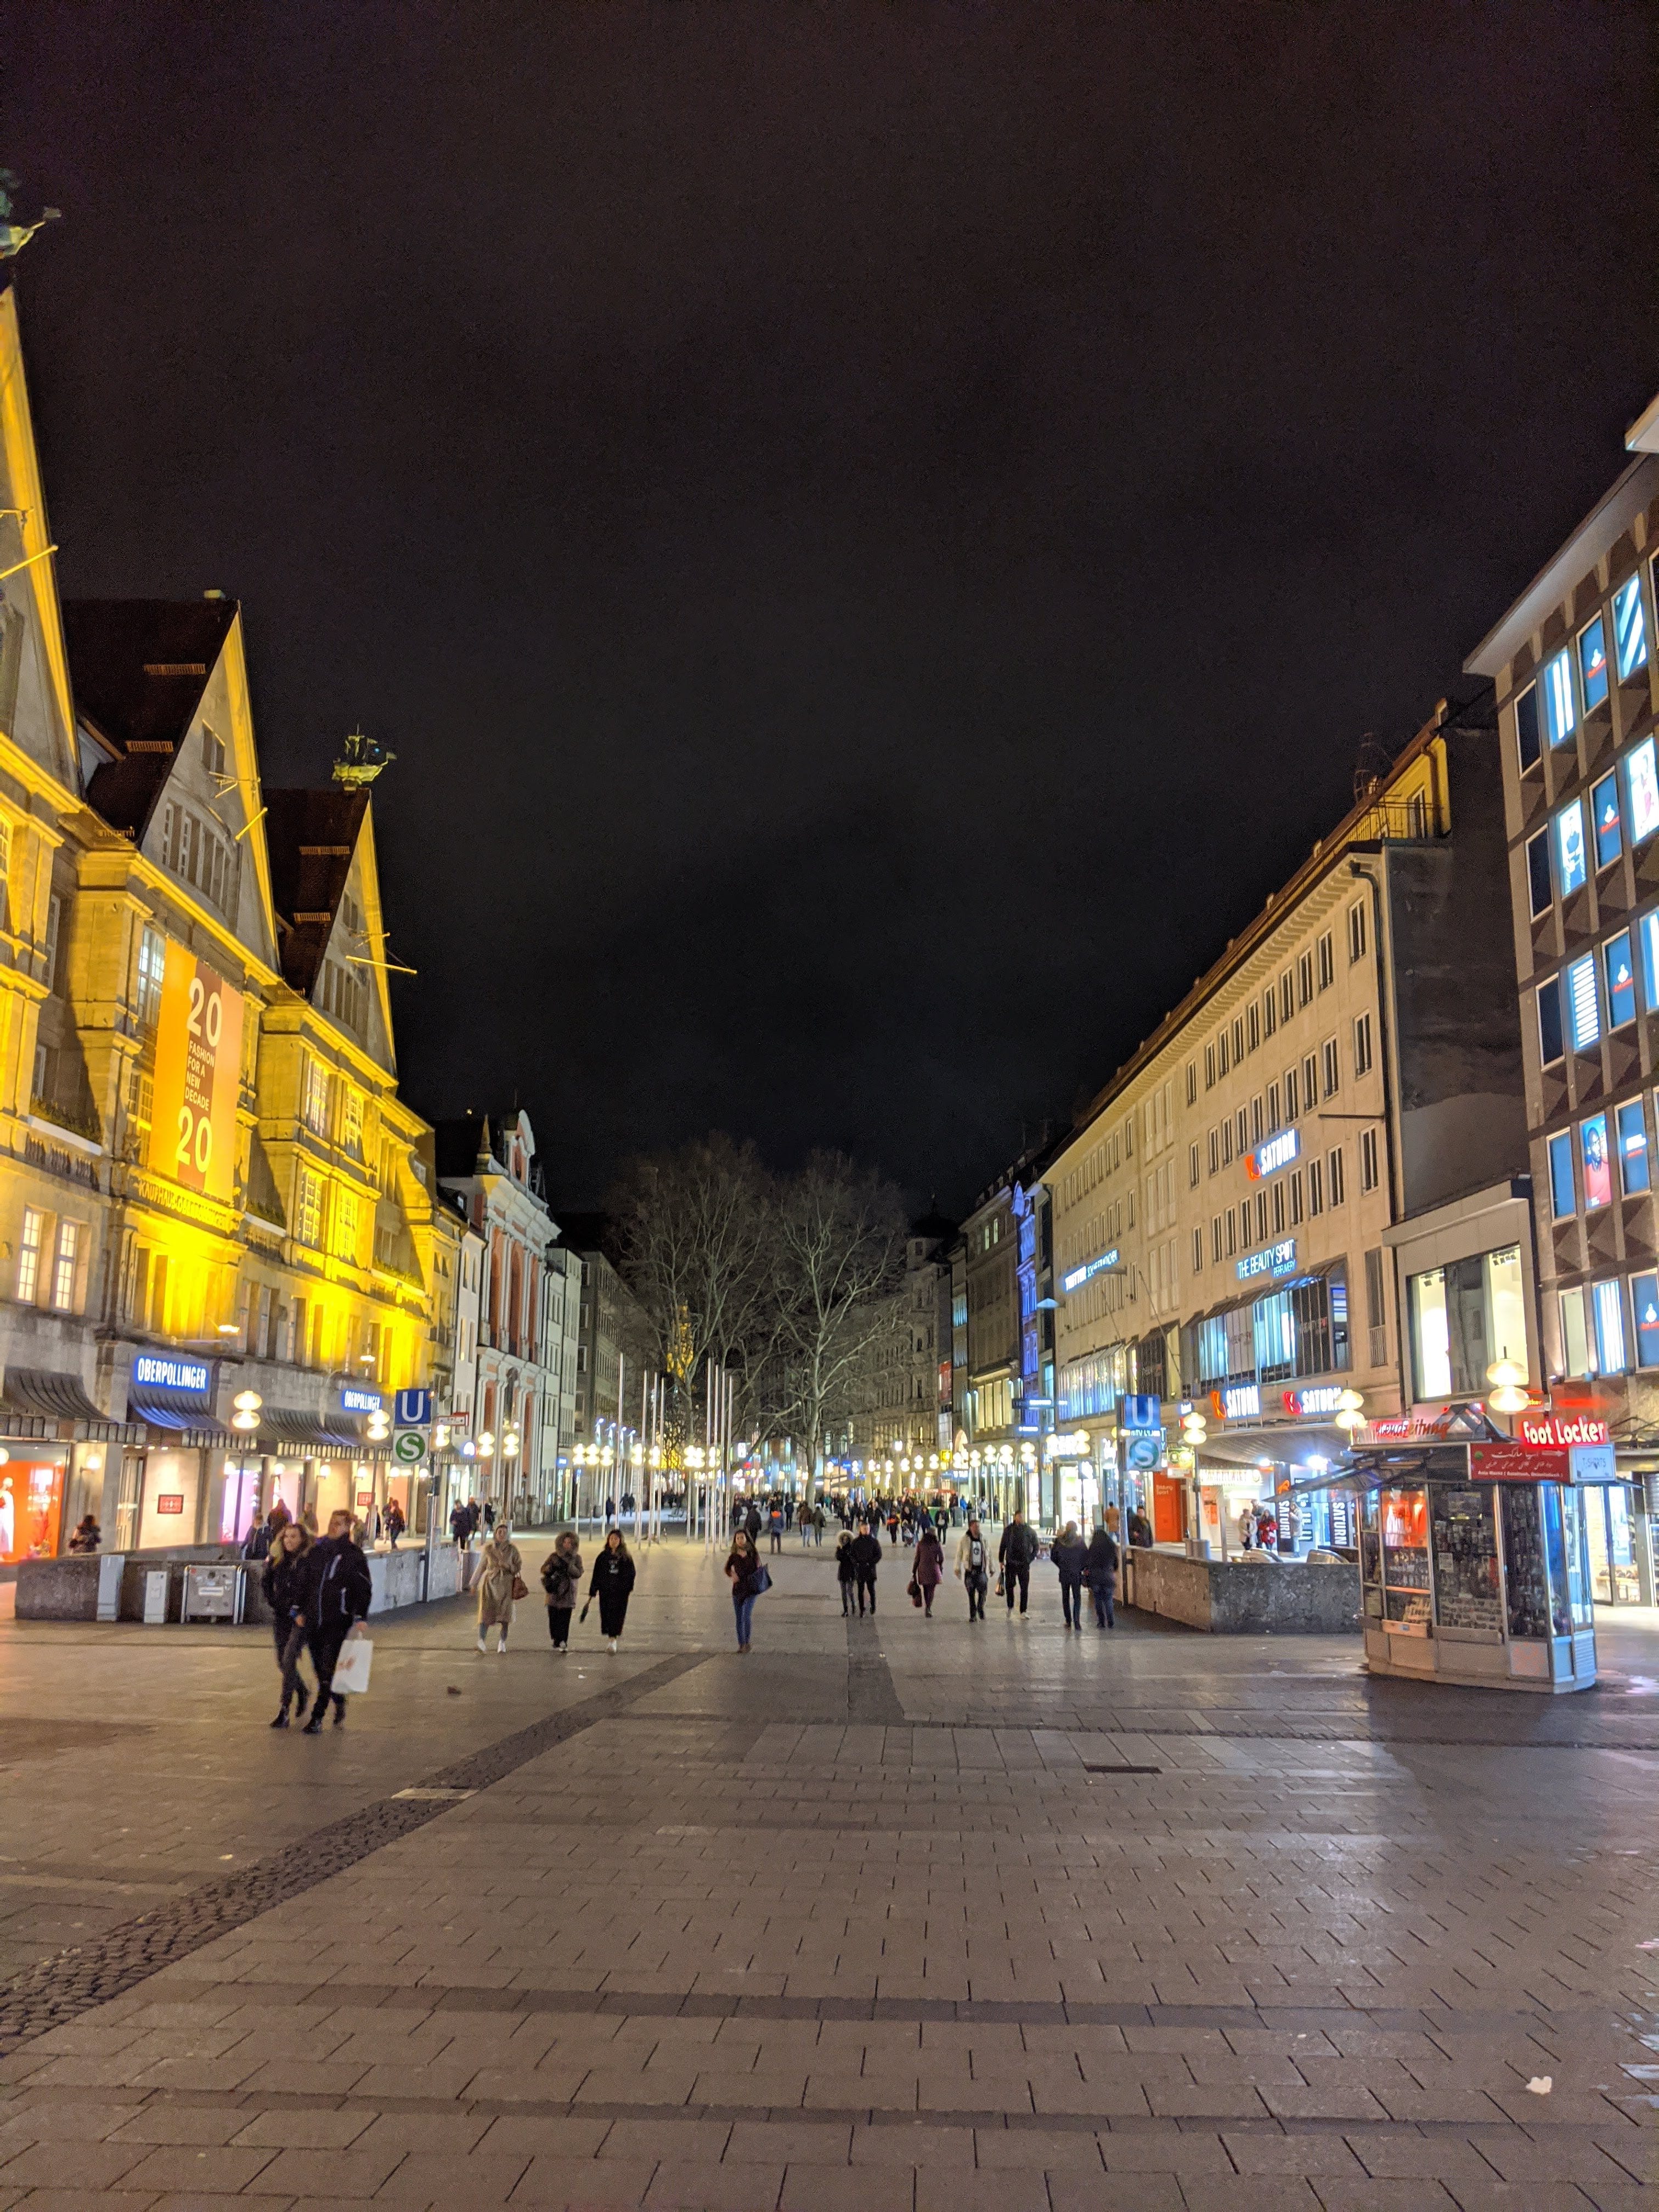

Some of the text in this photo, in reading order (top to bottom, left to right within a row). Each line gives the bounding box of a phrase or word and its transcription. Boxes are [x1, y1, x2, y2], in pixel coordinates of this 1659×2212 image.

[187, 978, 223, 1047] 20
[188, 1056, 205, 1077] FOR A
[189, 1040, 215, 1068] FASHION
[187, 1071, 200, 1090] NEW
[185, 1086, 210, 1111] DECADE
[175, 1105, 212, 1173] 20
[1261, 1128, 1295, 1175] SATURN
[1238, 1239, 1294, 1279] THE BEAUTY SPOT
[138, 1357, 206, 1389] OBERPOLLINGER
[345, 1390, 380, 1410] OBERPOLLINGER
[402, 1391, 424, 1422] U
[1132, 1397, 1153, 1426] U
[1226, 1385, 1260, 1418] SATURN
[1302, 1387, 1342, 1414] SATURN
[1523, 1417, 1604, 1444] Foot Locker
[400, 1435, 420, 1459] S
[1134, 1441, 1154, 1466] S
[1279, 1500, 1291, 1539] SATURN
[1333, 1502, 1347, 1545] SATURN
